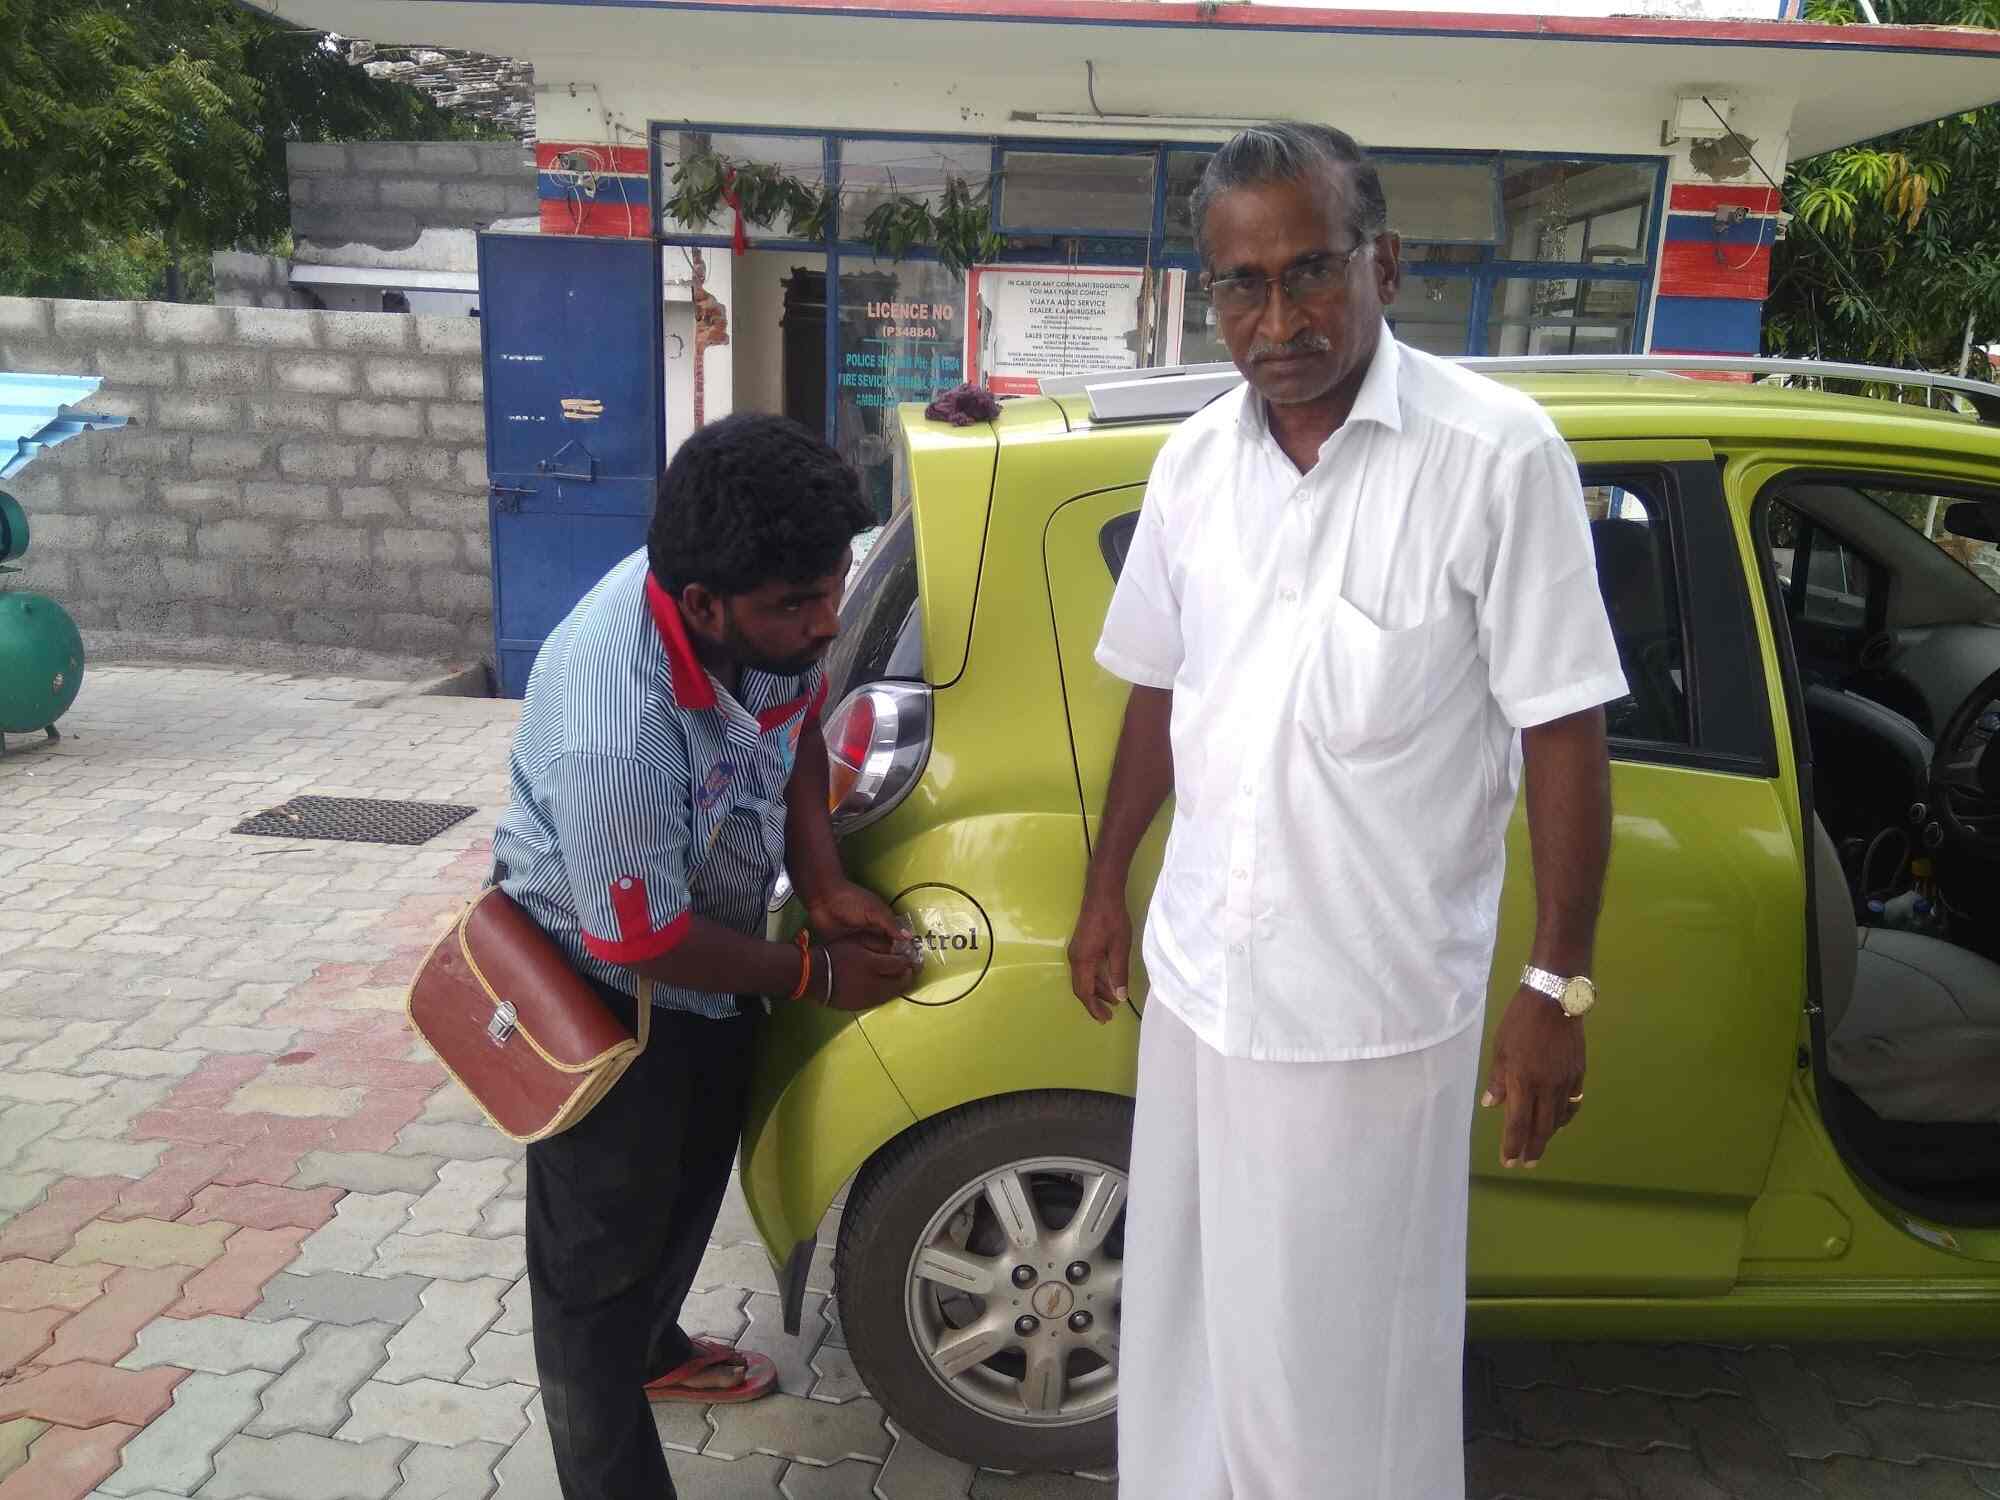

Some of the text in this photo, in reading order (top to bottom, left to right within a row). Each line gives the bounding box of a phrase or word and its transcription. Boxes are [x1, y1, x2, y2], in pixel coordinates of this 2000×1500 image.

[1080, 289, 1108, 297] CONTACT
[867, 302, 953, 320] LICENCE NO
[846, 353, 876, 368] POLICE
[911, 927, 979, 950] etrol
